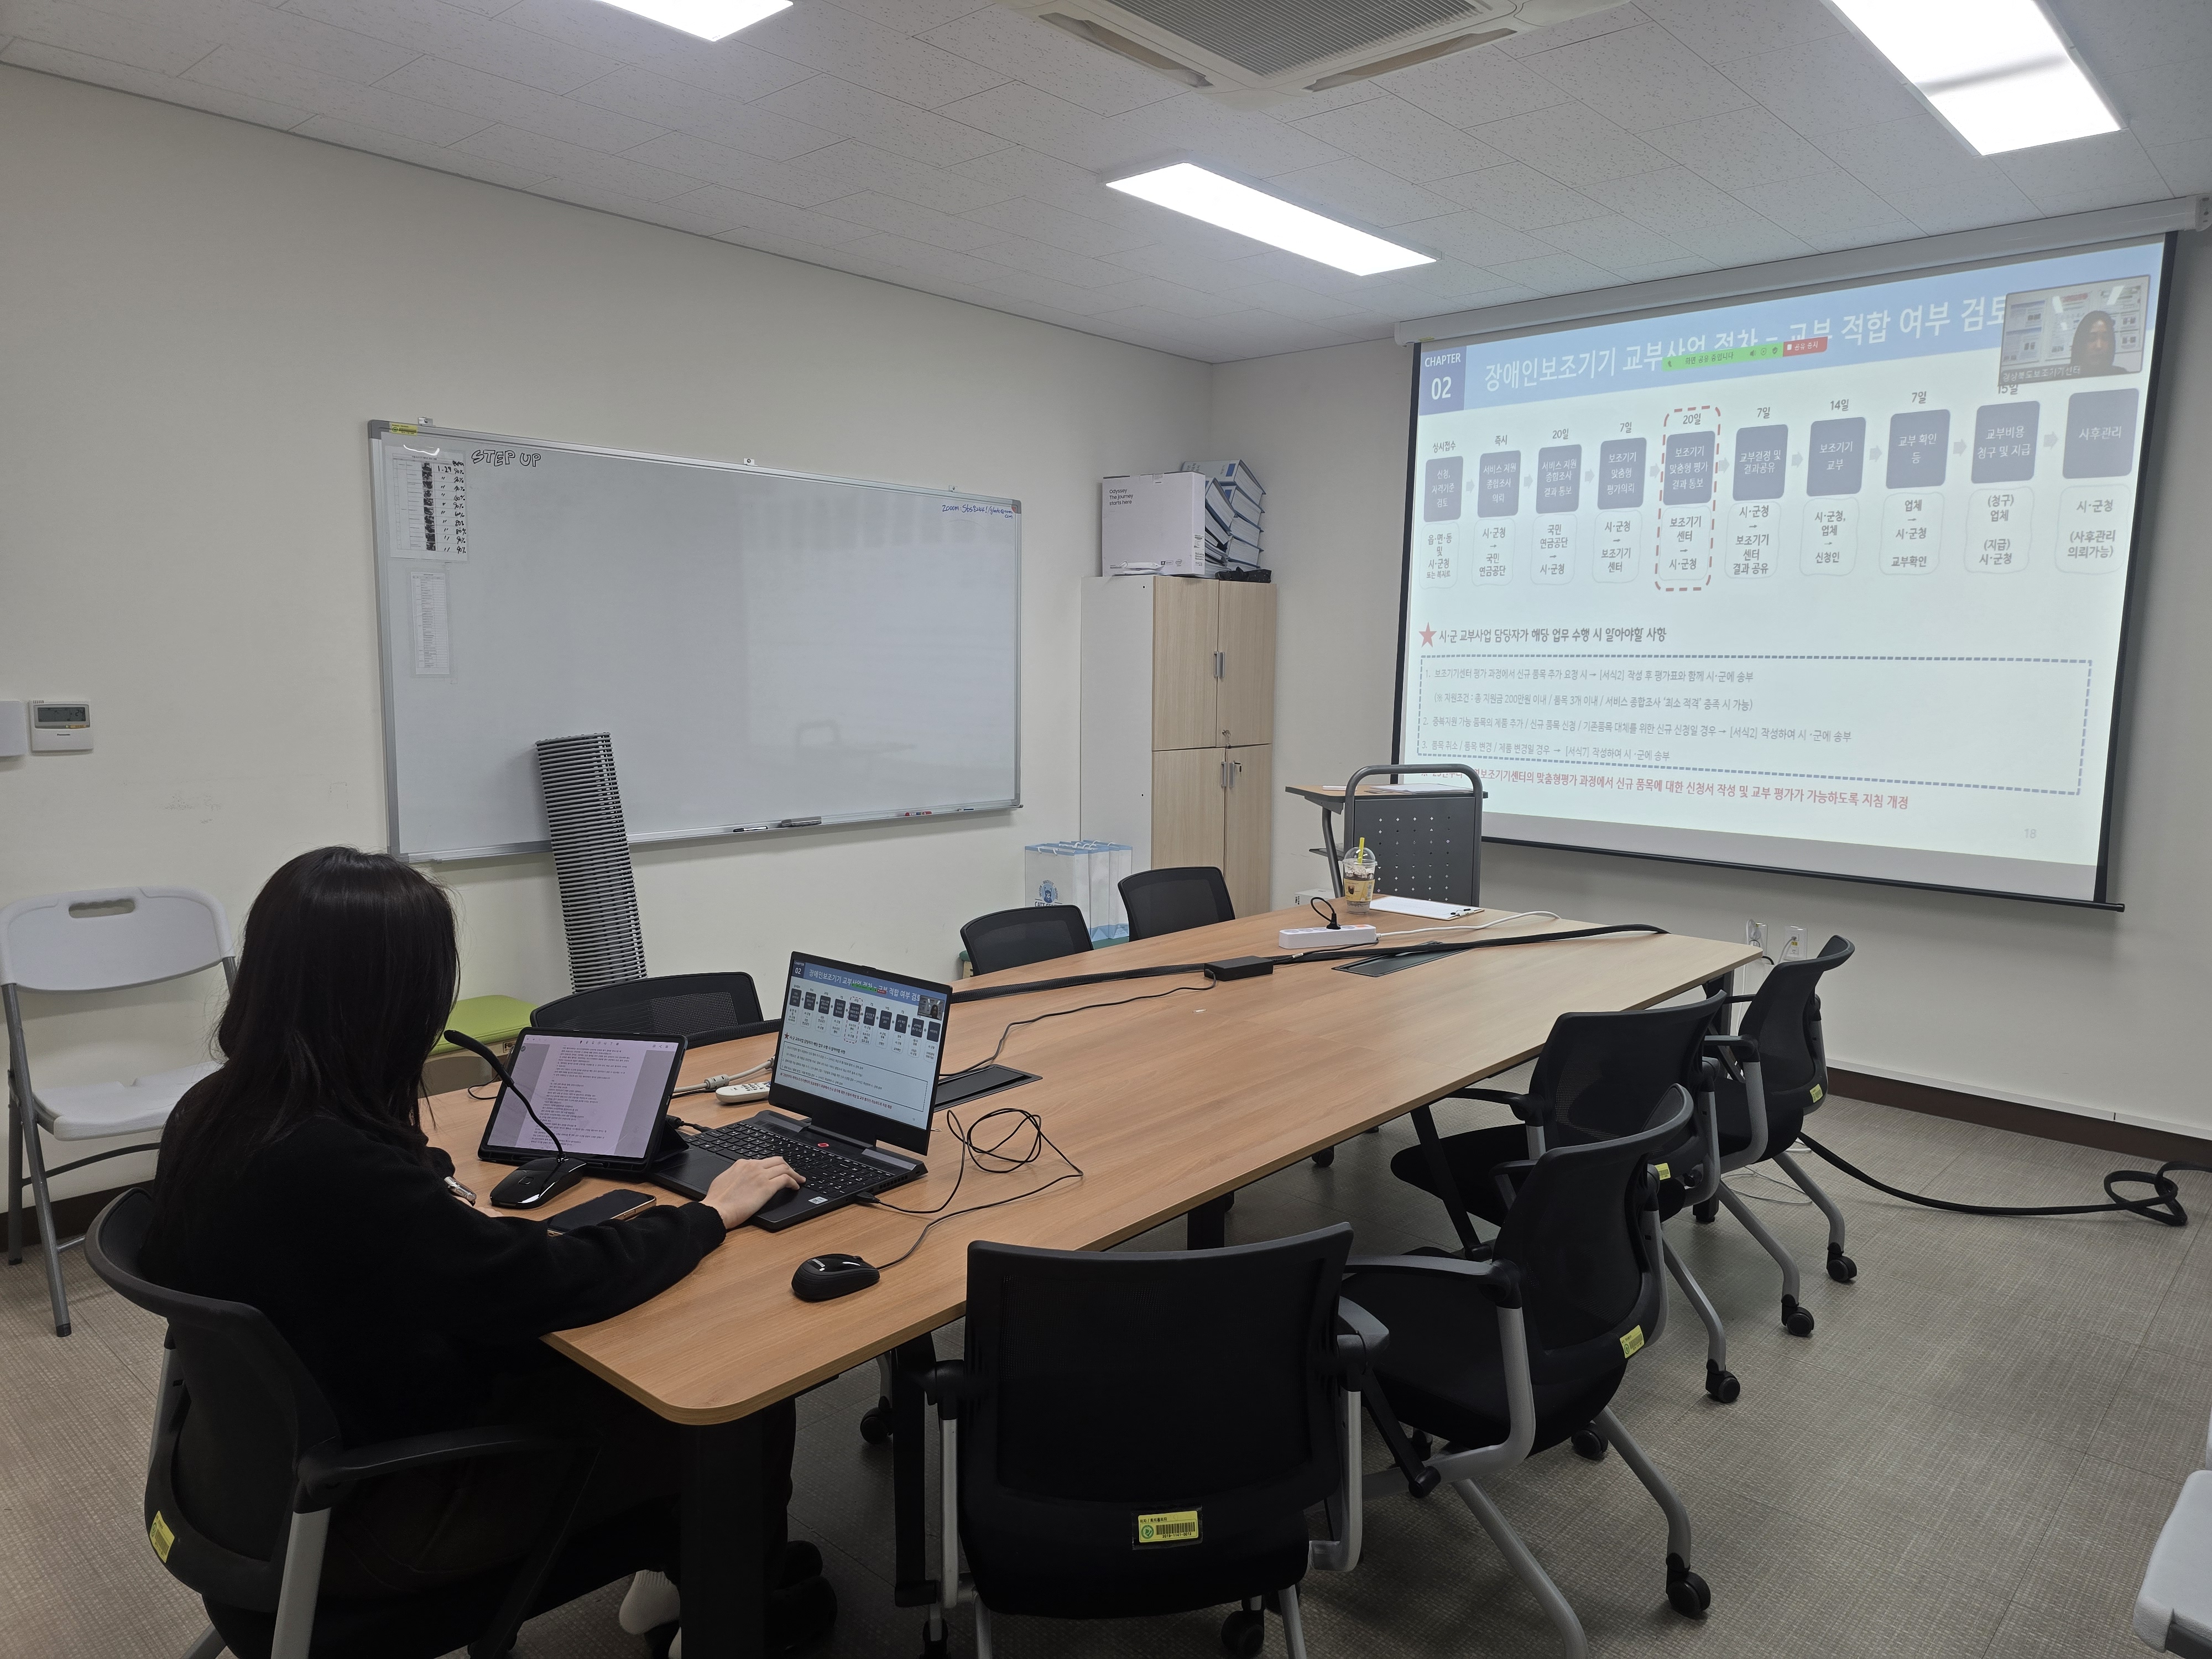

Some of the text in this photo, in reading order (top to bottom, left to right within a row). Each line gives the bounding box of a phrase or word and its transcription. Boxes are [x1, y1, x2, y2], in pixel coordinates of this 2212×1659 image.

[1485, 347, 1616, 392] 장애인보조기기
[1841, 310, 1891, 346] 적합
[1900, 302, 1950, 338] 여부
[1425, 352, 1461, 367] CHAPTER
[1685, 352, 1734, 365] 화면 공유 중입니다
[1431, 376, 1452, 399] 02
[1911, 391, 1927, 404] 7일
[1829, 399, 1849, 411] 14일
[1682, 413, 1701, 425] 20일
[1757, 407, 1770, 419] 7일
[1620, 421, 1632, 434] 7일
[1985, 425, 2025, 440] 교부비용
[2079, 425, 2122, 440] 사후관리
[1552, 429, 1569, 440] 20일
[1898, 432, 1937, 447] 교부 확인
[1674, 445, 1704, 457] 보조기기
[1819, 441, 1853, 453] 보조기기
[1977, 444, 2031, 460] 청구 및 지급
[471, 449, 516, 467] STEP
[520, 452, 541, 467] UP
[1608, 451, 1636, 463] 보조기기
[1911, 451, 1921, 464] 등
[1483, 464, 1503, 474] 서비스
[1542, 461, 1562, 472] 서비스
[1827, 458, 1844, 471] 교부
[1905, 499, 1923, 512] 업체
[1987, 494, 2015, 508] (청구)
[1670, 515, 1702, 528] 보조기기
[1990, 510, 2009, 522] 업체
[1547, 524, 1562, 535] 국민
[1677, 530, 1693, 542] 센터
[1821, 525, 1838, 536] 업체
[1540, 537, 1568, 549] 연금공단
[1735, 534, 1770, 546] 보조기기
[2070, 530, 2116, 543] (사후관리
[1984, 538, 2011, 551] (지급)
[1486, 553, 1499, 564] 국민
[1601, 547, 1631, 559] 보조기기
[1743, 549, 1760, 561] 센터
[1815, 551, 1840, 564] 신청인
[2067, 545, 2114, 559] 의뢰가능)
[1608, 561, 1623, 573] 센터
[1891, 555, 1927, 568] 교부확인
[1479, 565, 1506, 577] 연금공단
[1733, 562, 1769, 576] 결과 공유
[1459, 627, 1667, 643] 교부사업 담당자가 해당 업무 수행 시 알아야할 사항
[1434, 668, 1472, 679] 보조기기센터
[1474, 668, 1486, 679] 평가
[1488, 668, 1515, 679] 과정에서
[1517, 669, 1531, 679] 신규
[1548, 669, 1562, 680] 추가
[1580, 669, 1588, 680] 시
[1627, 670, 1642, 681] 작성
[1644, 670, 1653, 681] 후
[1655, 670, 1686, 682] 평가표와
[1688, 671, 1704, 682] 함께
[1736, 671, 1754, 683] 송부
[1505, 694, 1531, 705] 200만원
[1605, 696, 1628, 707] 서비스
[1630, 696, 1661, 708] 종합조사
[1722, 698, 1730, 710] 시
[1732, 698, 1753, 711] 가능)
[1639, 723, 1655, 735] 위한
[1656, 723, 1672, 735] 신규
[1761, 727, 1795, 740] 작성하여
[1833, 730, 1852, 743] 송부
[1592, 747, 1622, 760] 작성하여
[1654, 750, 1670, 762] 송부
[1536, 772, 1908, 810] 맞춤형평가 과정에서 신규 품목에 대한 신청서 작성 및 교부 평가가 가능하도록 지침 개정
[2025, 828, 2037, 838] 18
[809, 969, 841, 984] 장애인보조기기
[900, 990, 910, 1000] 여부
